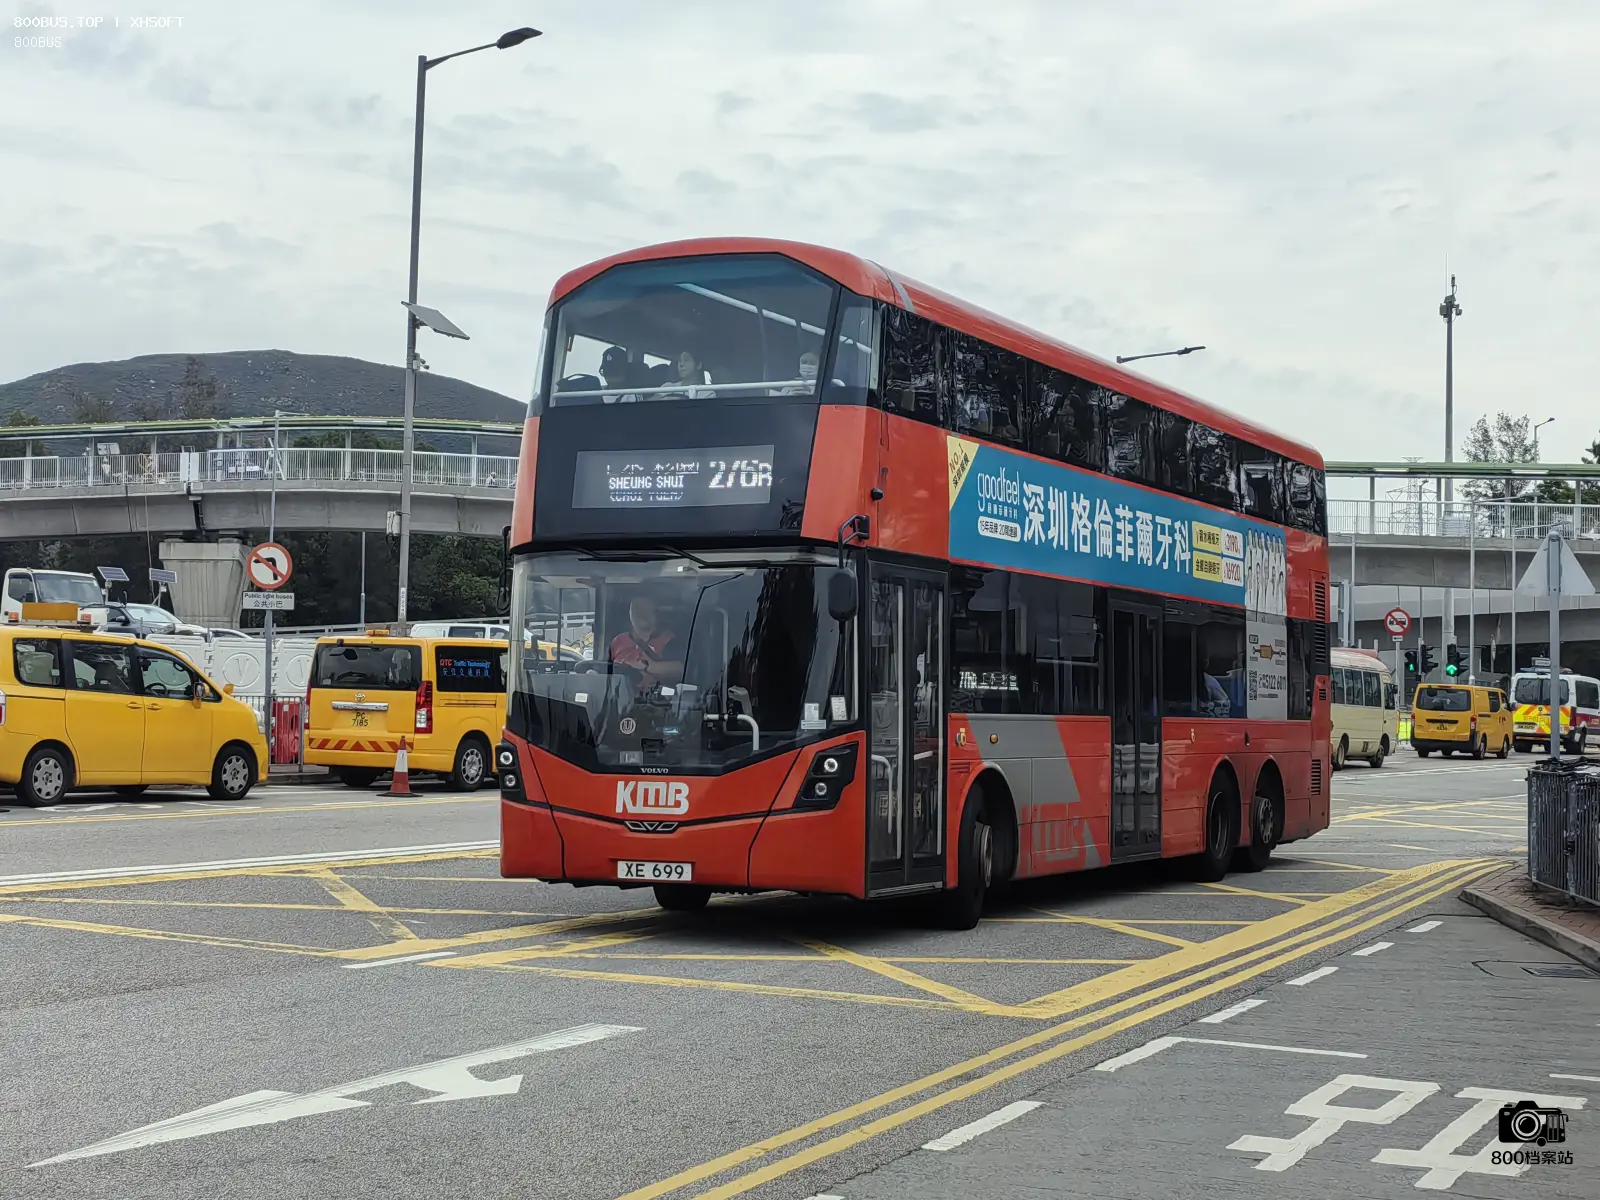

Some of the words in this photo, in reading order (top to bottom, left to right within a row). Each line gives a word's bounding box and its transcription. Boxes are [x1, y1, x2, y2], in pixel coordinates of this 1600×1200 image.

[608, 476, 652, 490] SHEUNG
[656, 475, 684, 488] SHUI
[977, 466, 1020, 513] goodfeel
[1022, 480, 1191, 575] 深圳格倫菲爾牙科
[253, 600, 284, 608] 公共小巴
[351, 719, 369, 727] 7185
[355, 711, 366, 720] PC
[615, 780, 690, 815] KMB
[624, 862, 646, 877] XE
[652, 863, 685, 879] 699
